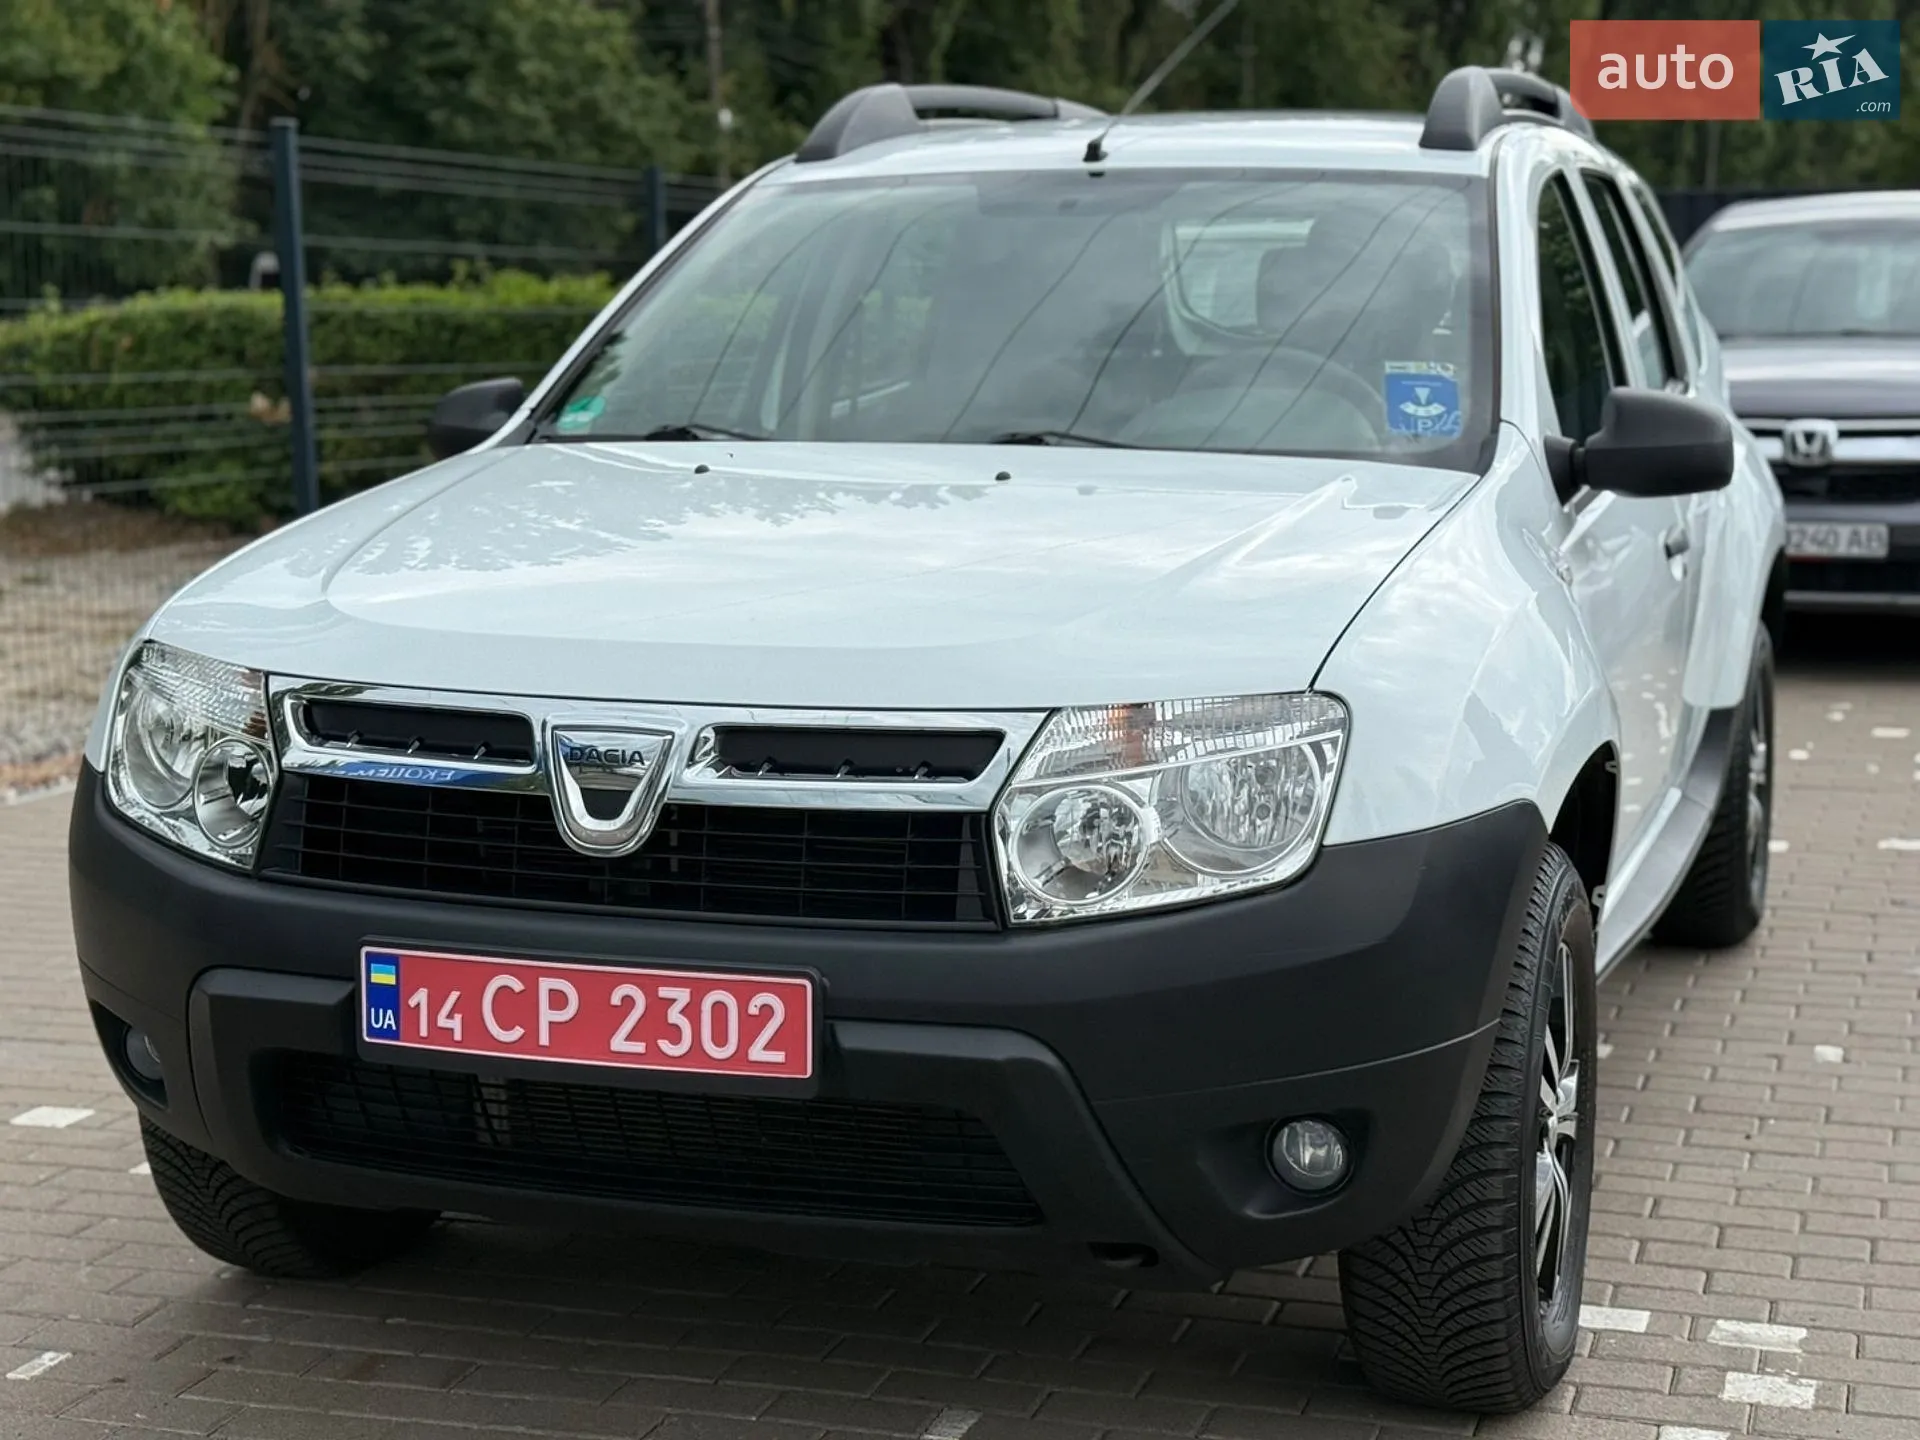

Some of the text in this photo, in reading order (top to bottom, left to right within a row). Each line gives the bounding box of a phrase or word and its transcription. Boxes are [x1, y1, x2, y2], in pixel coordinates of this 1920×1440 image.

[567, 746, 646, 766] DACIA
[370, 1007, 397, 1031] UA
[407, 974, 787, 1064] 14 CP 2302
